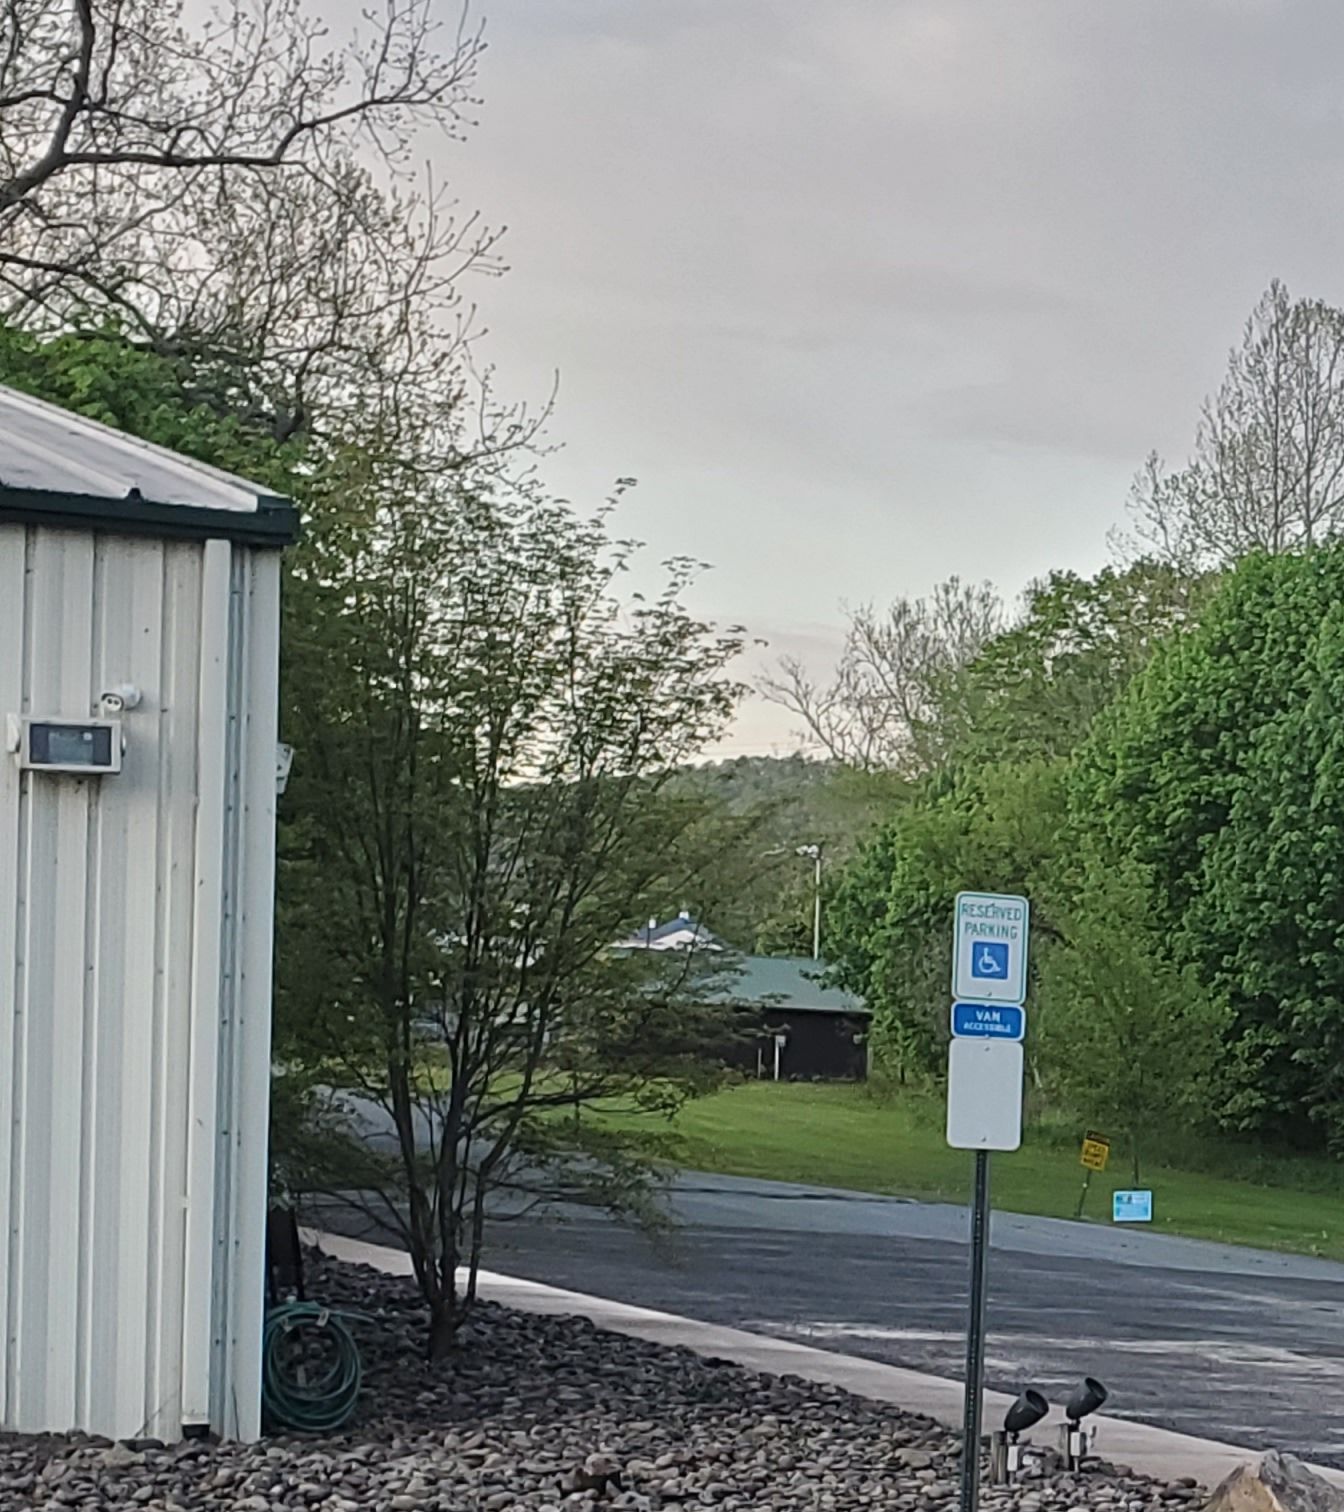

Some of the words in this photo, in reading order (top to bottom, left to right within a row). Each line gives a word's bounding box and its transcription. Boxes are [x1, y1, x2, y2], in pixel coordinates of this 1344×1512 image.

[962, 903, 1021, 921] RESERVED
[964, 922, 1018, 939] PARKING
[976, 1010, 1001, 1023] VAN
